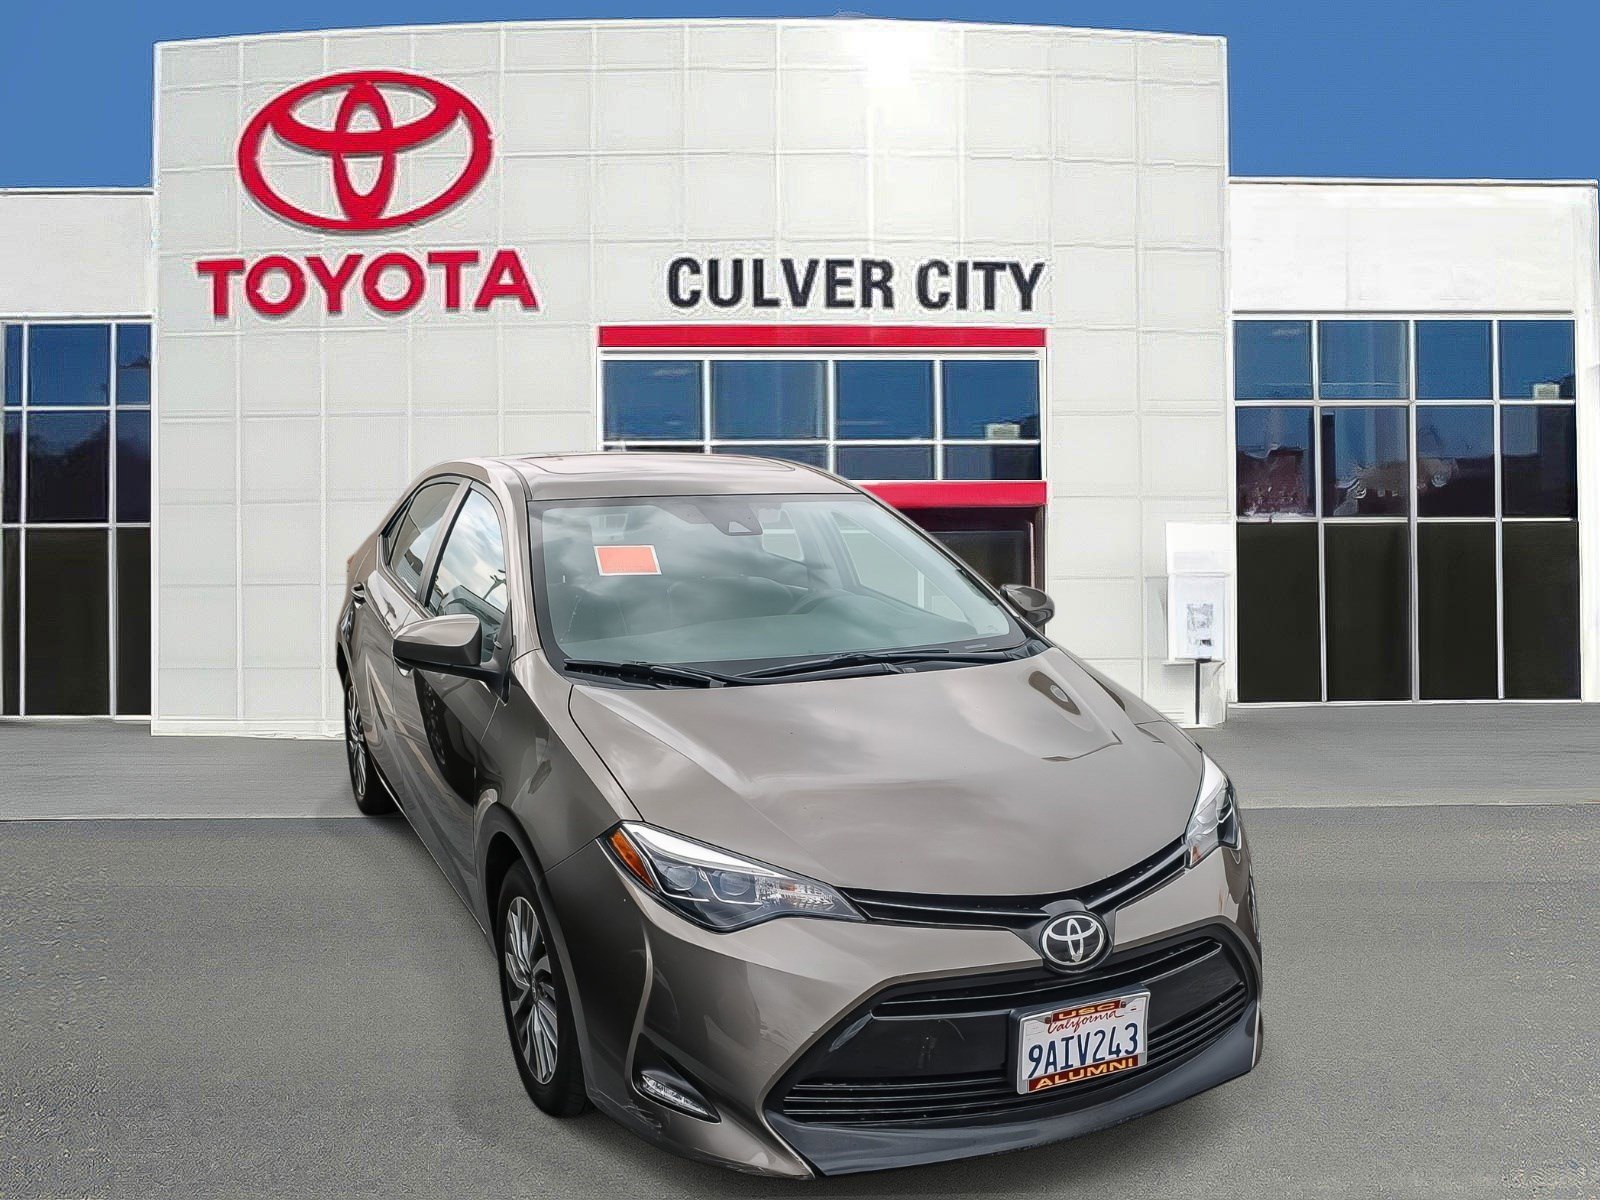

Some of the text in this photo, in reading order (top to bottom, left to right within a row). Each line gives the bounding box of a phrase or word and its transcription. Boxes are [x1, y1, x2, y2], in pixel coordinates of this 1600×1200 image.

[195, 249, 539, 318] TOYOTA
[667, 256, 1045, 311] CULVER CITY
[1047, 1010, 1124, 1034] California
[1058, 1002, 1116, 1019] USC
[1027, 1022, 1138, 1079] 9AIV243
[1035, 1058, 1133, 1088] ALUMNI
